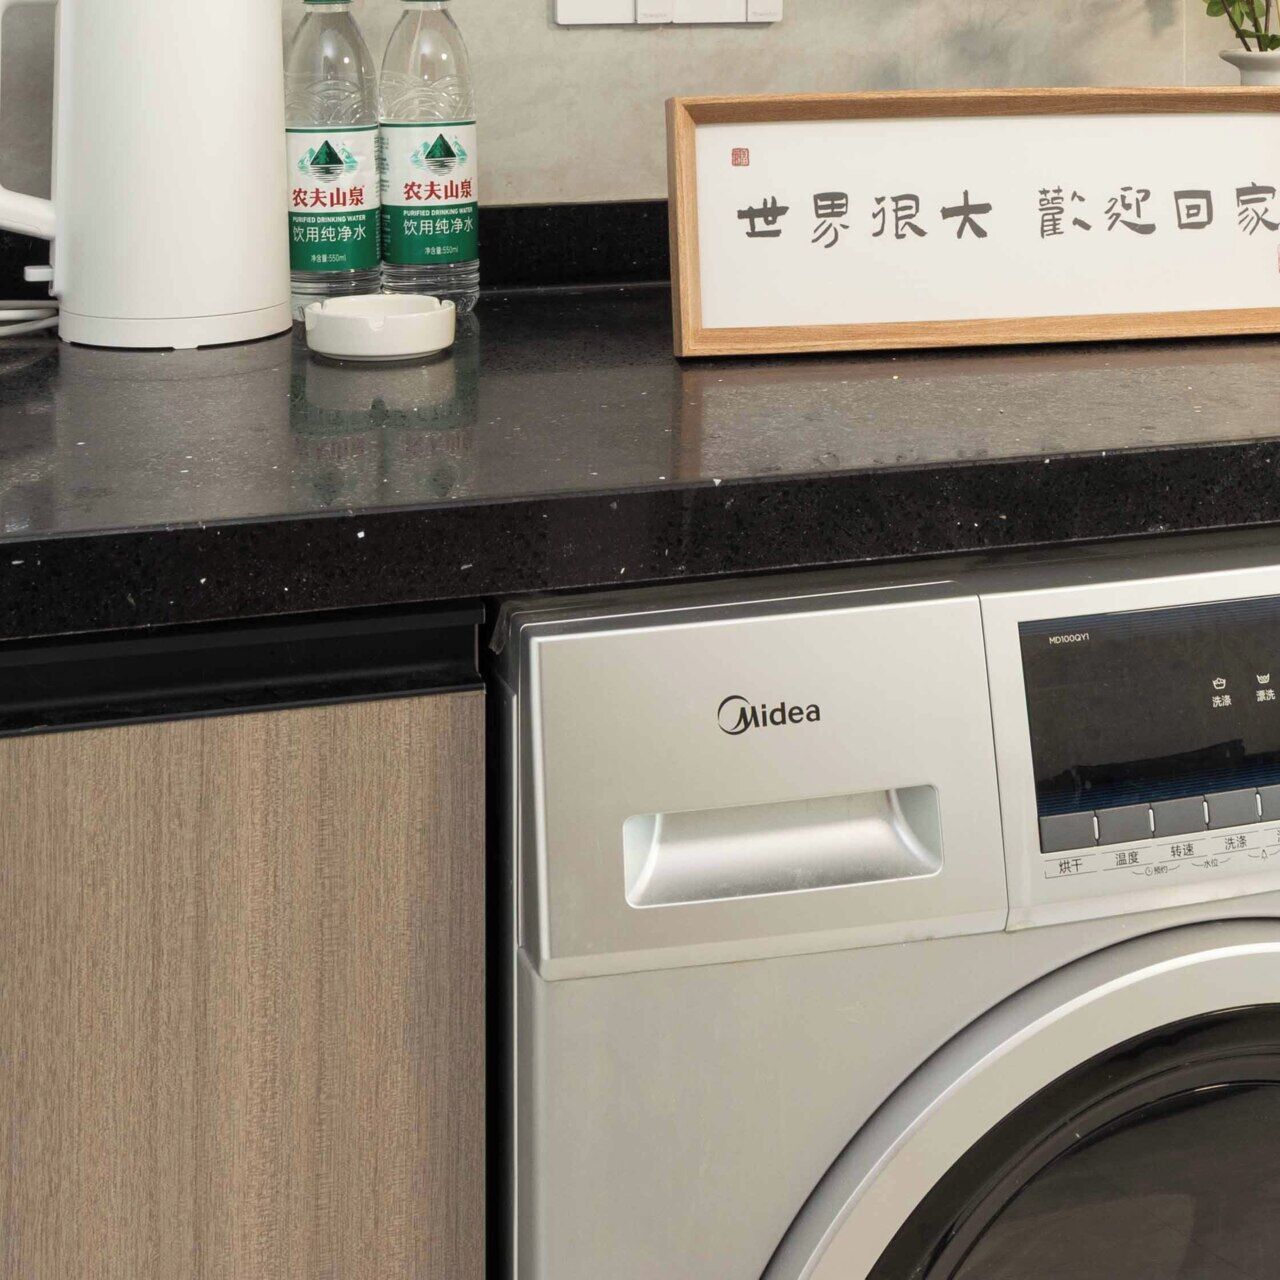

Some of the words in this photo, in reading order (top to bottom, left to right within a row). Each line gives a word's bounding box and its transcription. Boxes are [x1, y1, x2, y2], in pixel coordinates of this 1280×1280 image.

[292, 186, 364, 207] 农夫山泉
[404, 179, 472, 200] 农夫山泉
[317, 215, 346, 223] DRINKING
[431, 208, 458, 216] DRINKING
[737, 190, 992, 248] 世界很大
[1038, 181, 1280, 239] 歡迎回家
[293, 224, 366, 242] 饮用纯净水
[403, 216, 473, 235] 饮用纯净水
[1049, 633, 1089, 645] MD100QY1
[1212, 695, 1232, 708] 洗涤
[1256, 689, 1276, 702] 漂洗
[718, 695, 821, 735] Midea
[1170, 843, 1195, 858] 转速
[1224, 835, 1248, 851] 洗涤
[1059, 859, 1083, 875] 烘干
[1116, 851, 1140, 867] 温度
[1204, 858, 1219, 868] 水位
[1154, 865, 1169, 875] 预约
